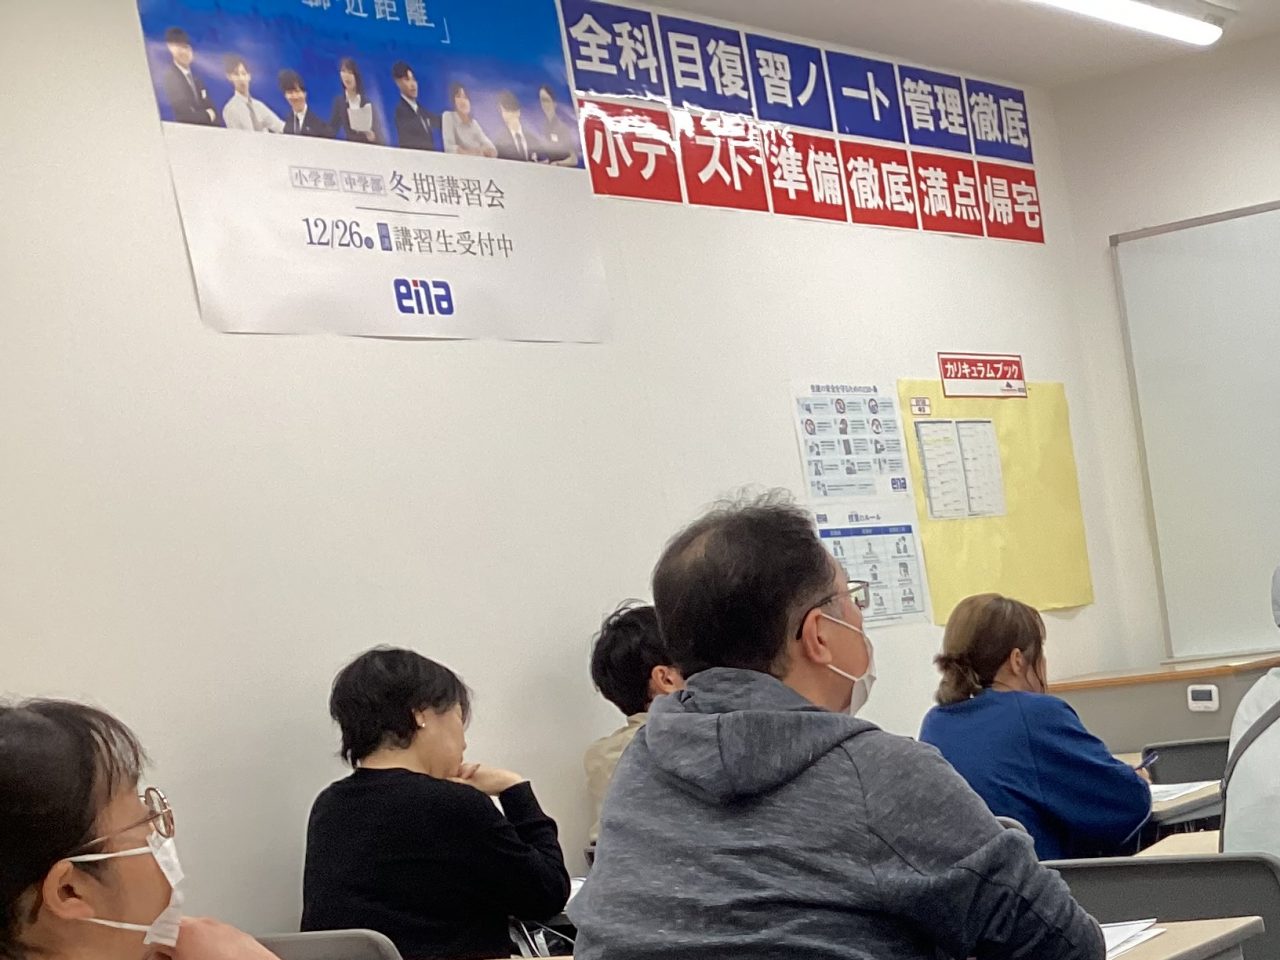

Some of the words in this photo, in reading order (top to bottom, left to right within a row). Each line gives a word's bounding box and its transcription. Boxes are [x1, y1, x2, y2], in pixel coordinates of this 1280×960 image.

[389, 170, 505, 209] 冬期講習会
[393, 226, 513, 258] 講習生受付中
[945, 361, 1019, 379] カリキュラムブック
